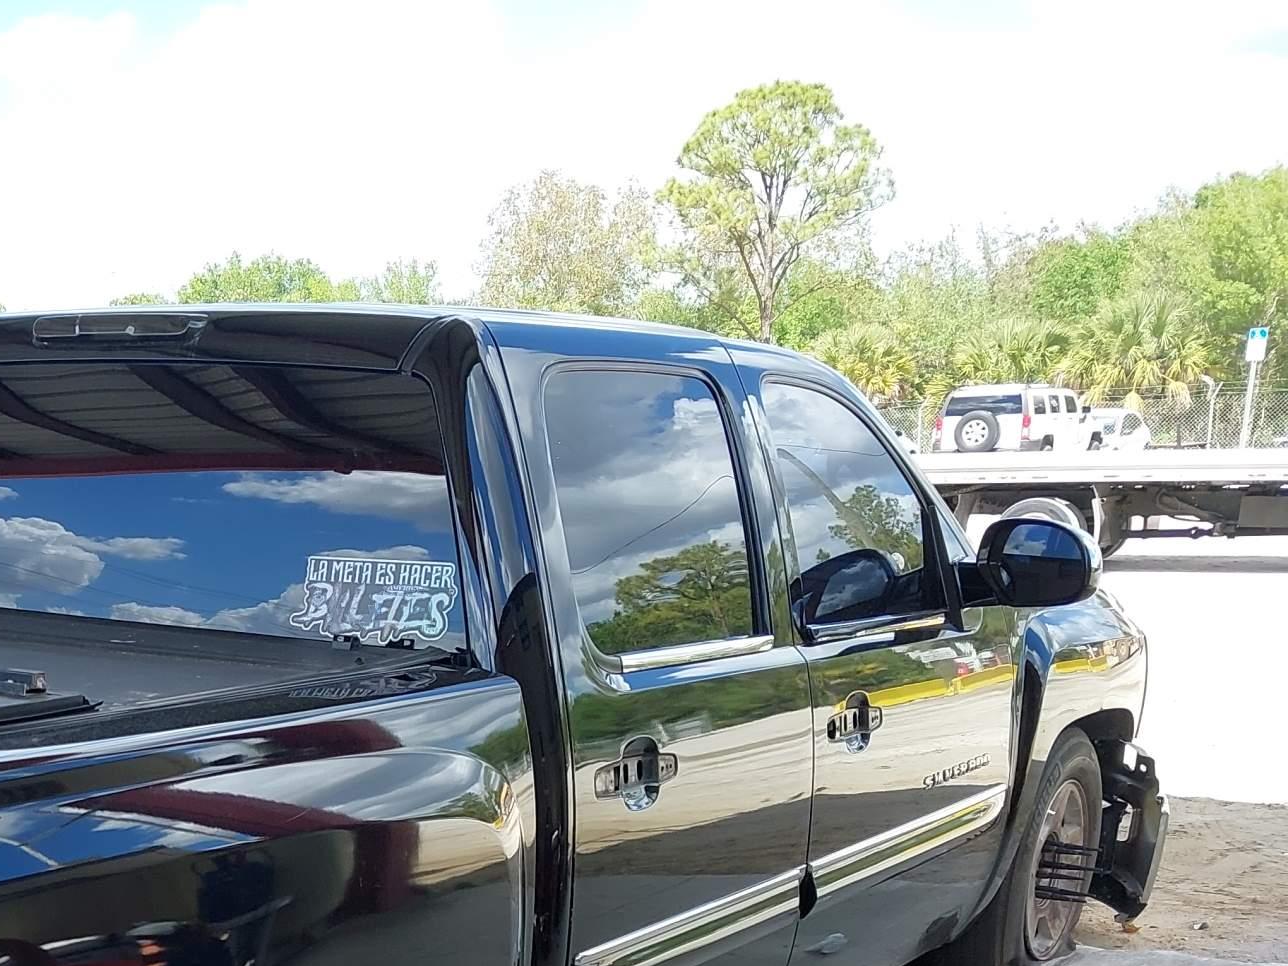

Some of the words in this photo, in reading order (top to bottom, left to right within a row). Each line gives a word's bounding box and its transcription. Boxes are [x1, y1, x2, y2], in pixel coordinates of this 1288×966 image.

[308, 558, 329, 582] LA
[330, 560, 373, 584] META
[375, 562, 396, 585] ES
[398, 563, 454, 588] HACER
